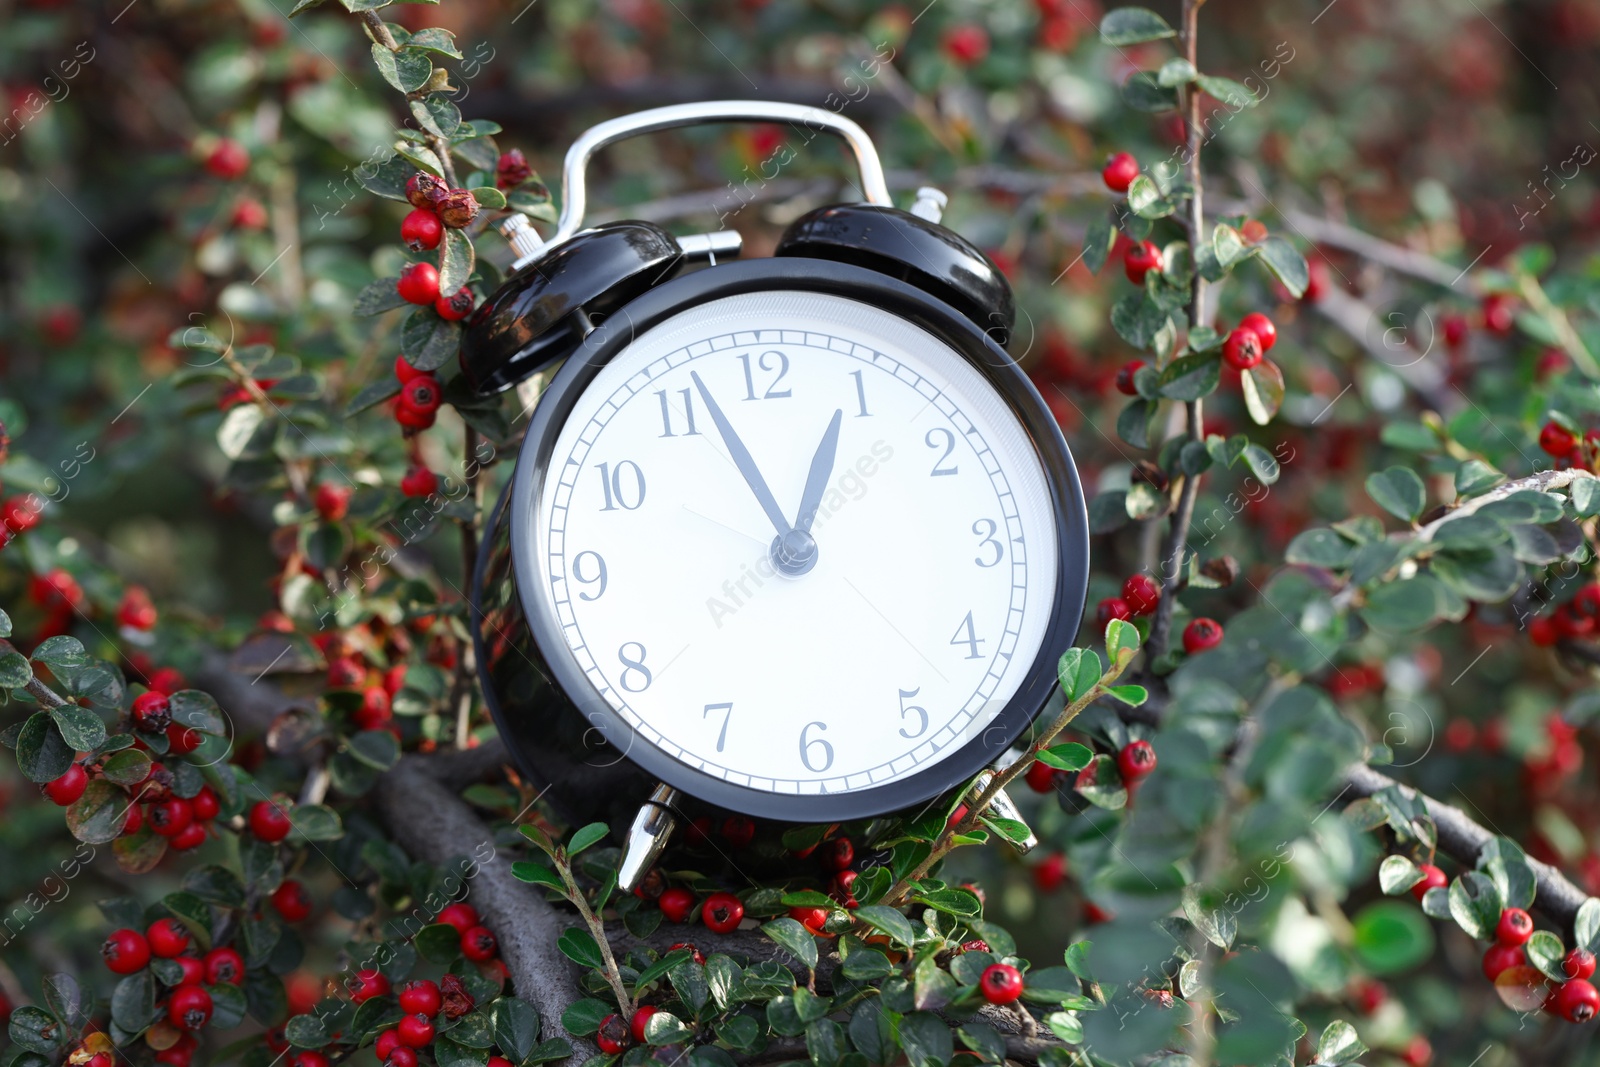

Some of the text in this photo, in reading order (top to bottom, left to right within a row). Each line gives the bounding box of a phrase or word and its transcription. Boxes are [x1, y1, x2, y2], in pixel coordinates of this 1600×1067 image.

[736, 350, 792, 400] 12
[849, 370, 875, 417] 1
[653, 386, 703, 437] 11
[925, 428, 959, 476] 2
[594, 460, 646, 512] 10
[972, 518, 1004, 567] 3
[572, 551, 608, 601] 9
[950, 610, 986, 660] 4
[618, 642, 652, 692] 8
[703, 702, 733, 752] 7
[899, 686, 929, 739] 5
[799, 721, 834, 772] 6
